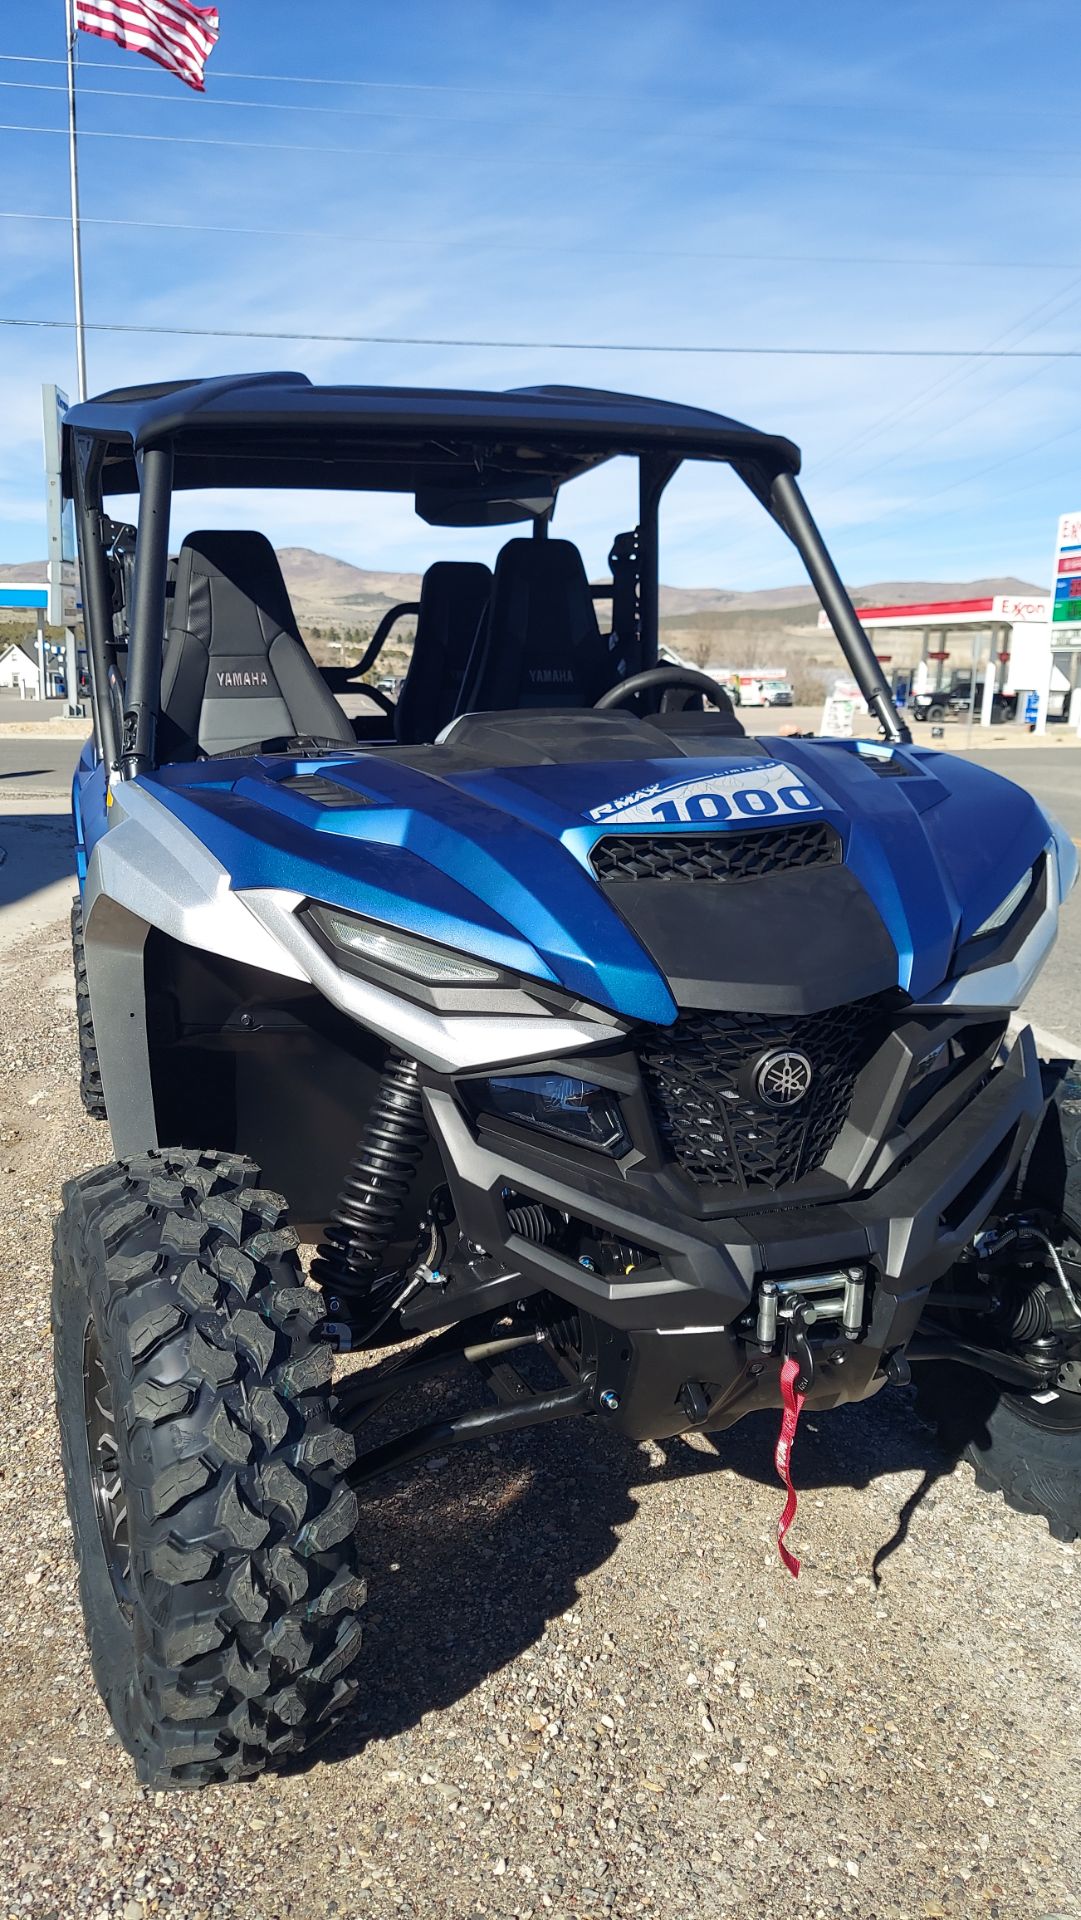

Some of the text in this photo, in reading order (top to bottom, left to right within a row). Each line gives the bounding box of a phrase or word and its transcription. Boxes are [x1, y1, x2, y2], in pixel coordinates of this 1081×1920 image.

[1001, 600, 1045, 621] Exxon
[216, 671, 268, 687] YAMAHA
[529, 669, 574, 683] YAMAHA
[713, 762, 775, 777] LIMITED
[589, 783, 662, 820] RMAX
[651, 785, 822, 822] 1000
